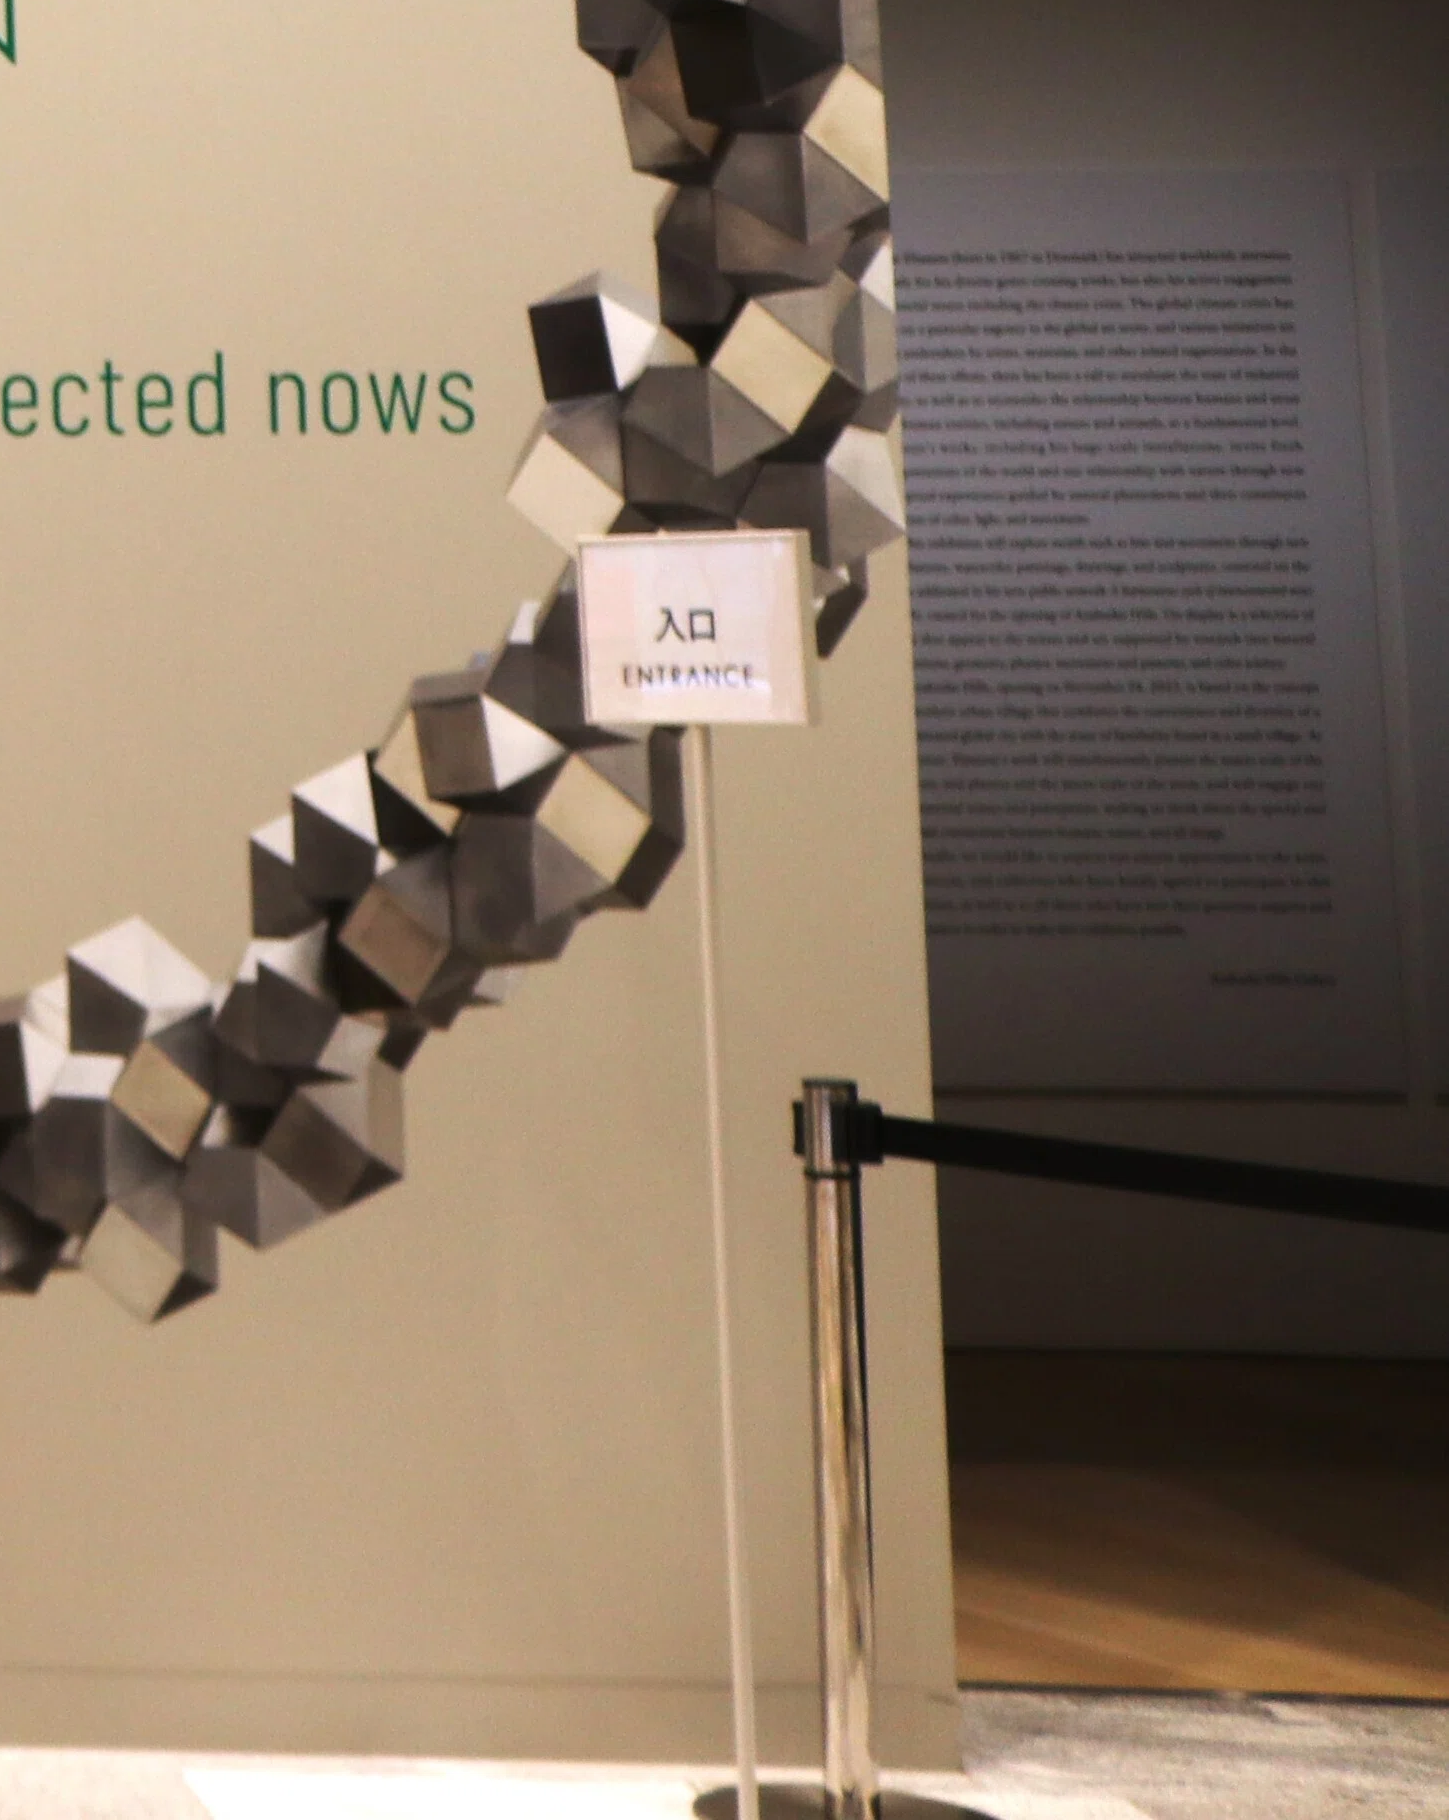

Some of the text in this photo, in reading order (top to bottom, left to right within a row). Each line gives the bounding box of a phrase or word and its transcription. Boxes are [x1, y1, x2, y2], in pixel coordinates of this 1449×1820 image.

[269, 371, 476, 435] nows
[655, 606, 717, 643] 入口
[621, 663, 755, 689] ENTRANCE
